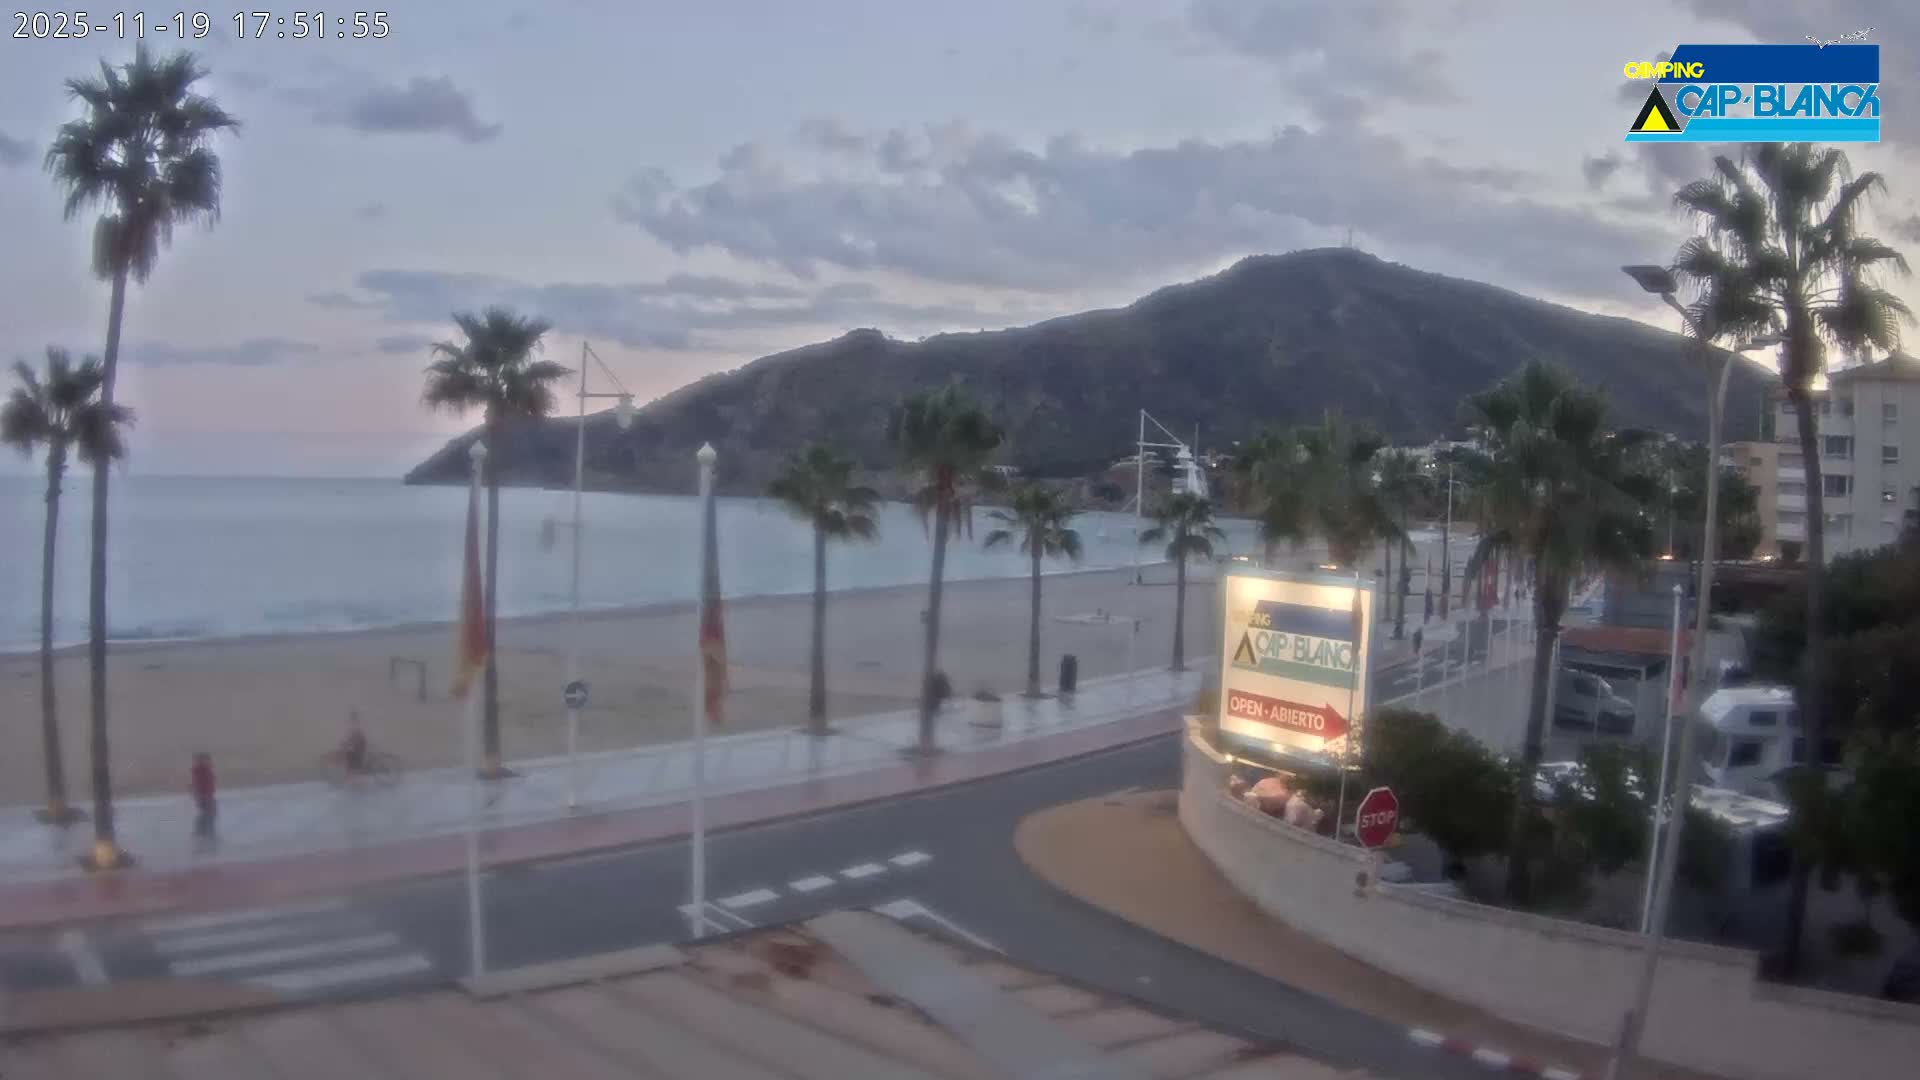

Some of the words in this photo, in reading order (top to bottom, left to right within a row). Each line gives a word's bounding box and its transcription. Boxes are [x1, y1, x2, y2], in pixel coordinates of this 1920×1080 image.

[1230, 696, 1263, 717] OPEN
[1270, 705, 1325, 731] ABIERTO
[1361, 810, 1394, 828] STOP
